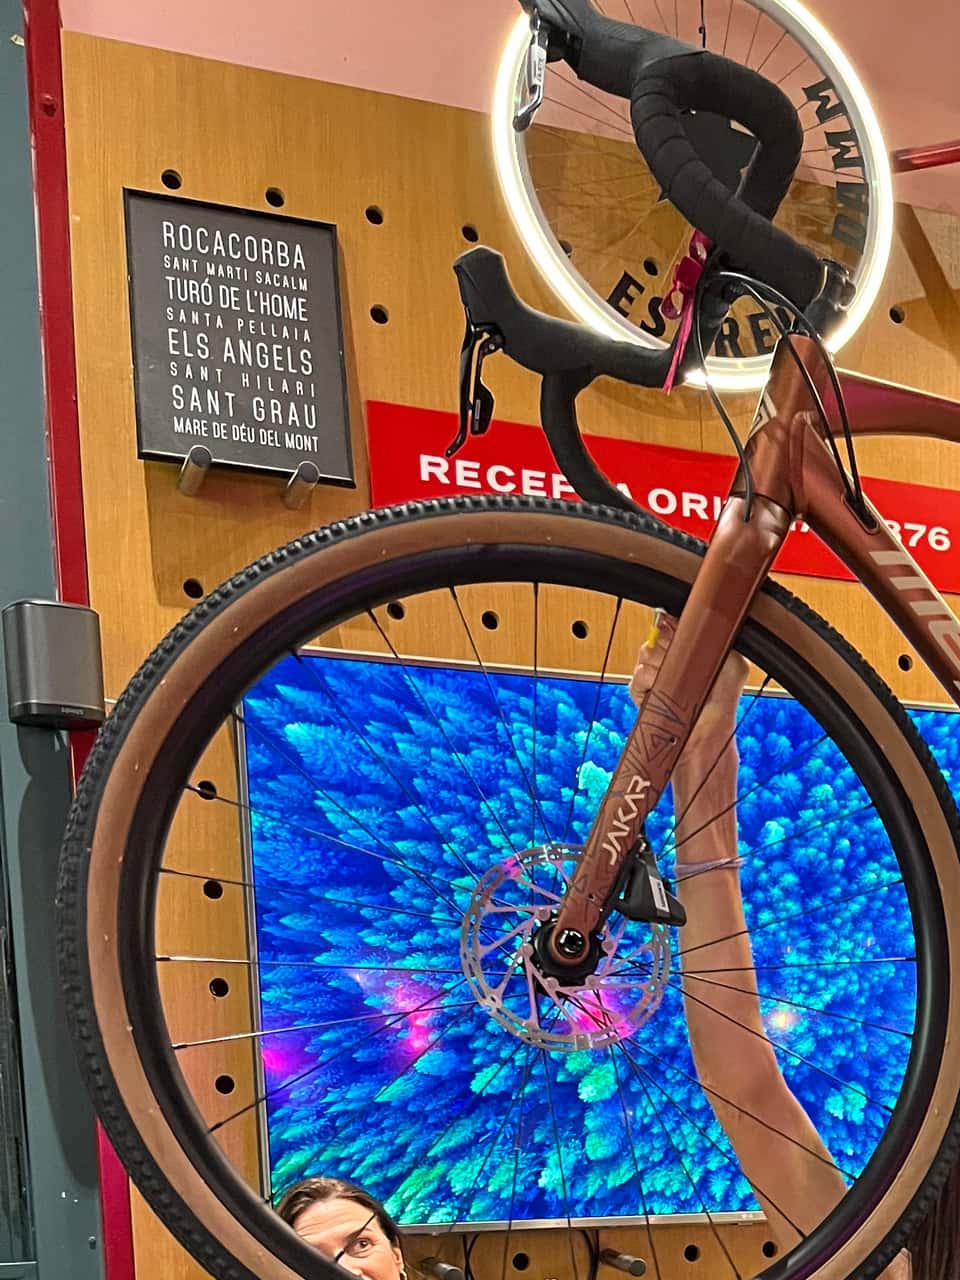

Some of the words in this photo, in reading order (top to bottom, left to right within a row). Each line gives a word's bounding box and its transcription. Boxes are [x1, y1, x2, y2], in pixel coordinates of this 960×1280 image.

[162, 221, 306, 271] ROCACORBA
[163, 254, 198, 273] SANT
[255, 270, 308, 292] SACALM
[165, 275, 213, 306] TURÓ
[219, 284, 241, 311] DE
[246, 289, 308, 321] L'HOME
[166, 306, 224, 329] SANTA
[237, 317, 311, 343] PELLAIA
[167, 327, 209, 359] ELS
[223, 336, 313, 376] ANGELS
[170, 361, 222, 384] SANT
[241, 372, 315, 398] HILARI
[172, 384, 236, 418] SANT
[252, 396, 316, 430] GRAU
[173, 416, 209, 437] MARE
[212, 421, 229, 440] DE
[231, 423, 255, 444] DÉU
[259, 428, 281, 447] DEL
[284, 431, 319, 453] MONT
[602, 774, 651, 866] JAKAR
